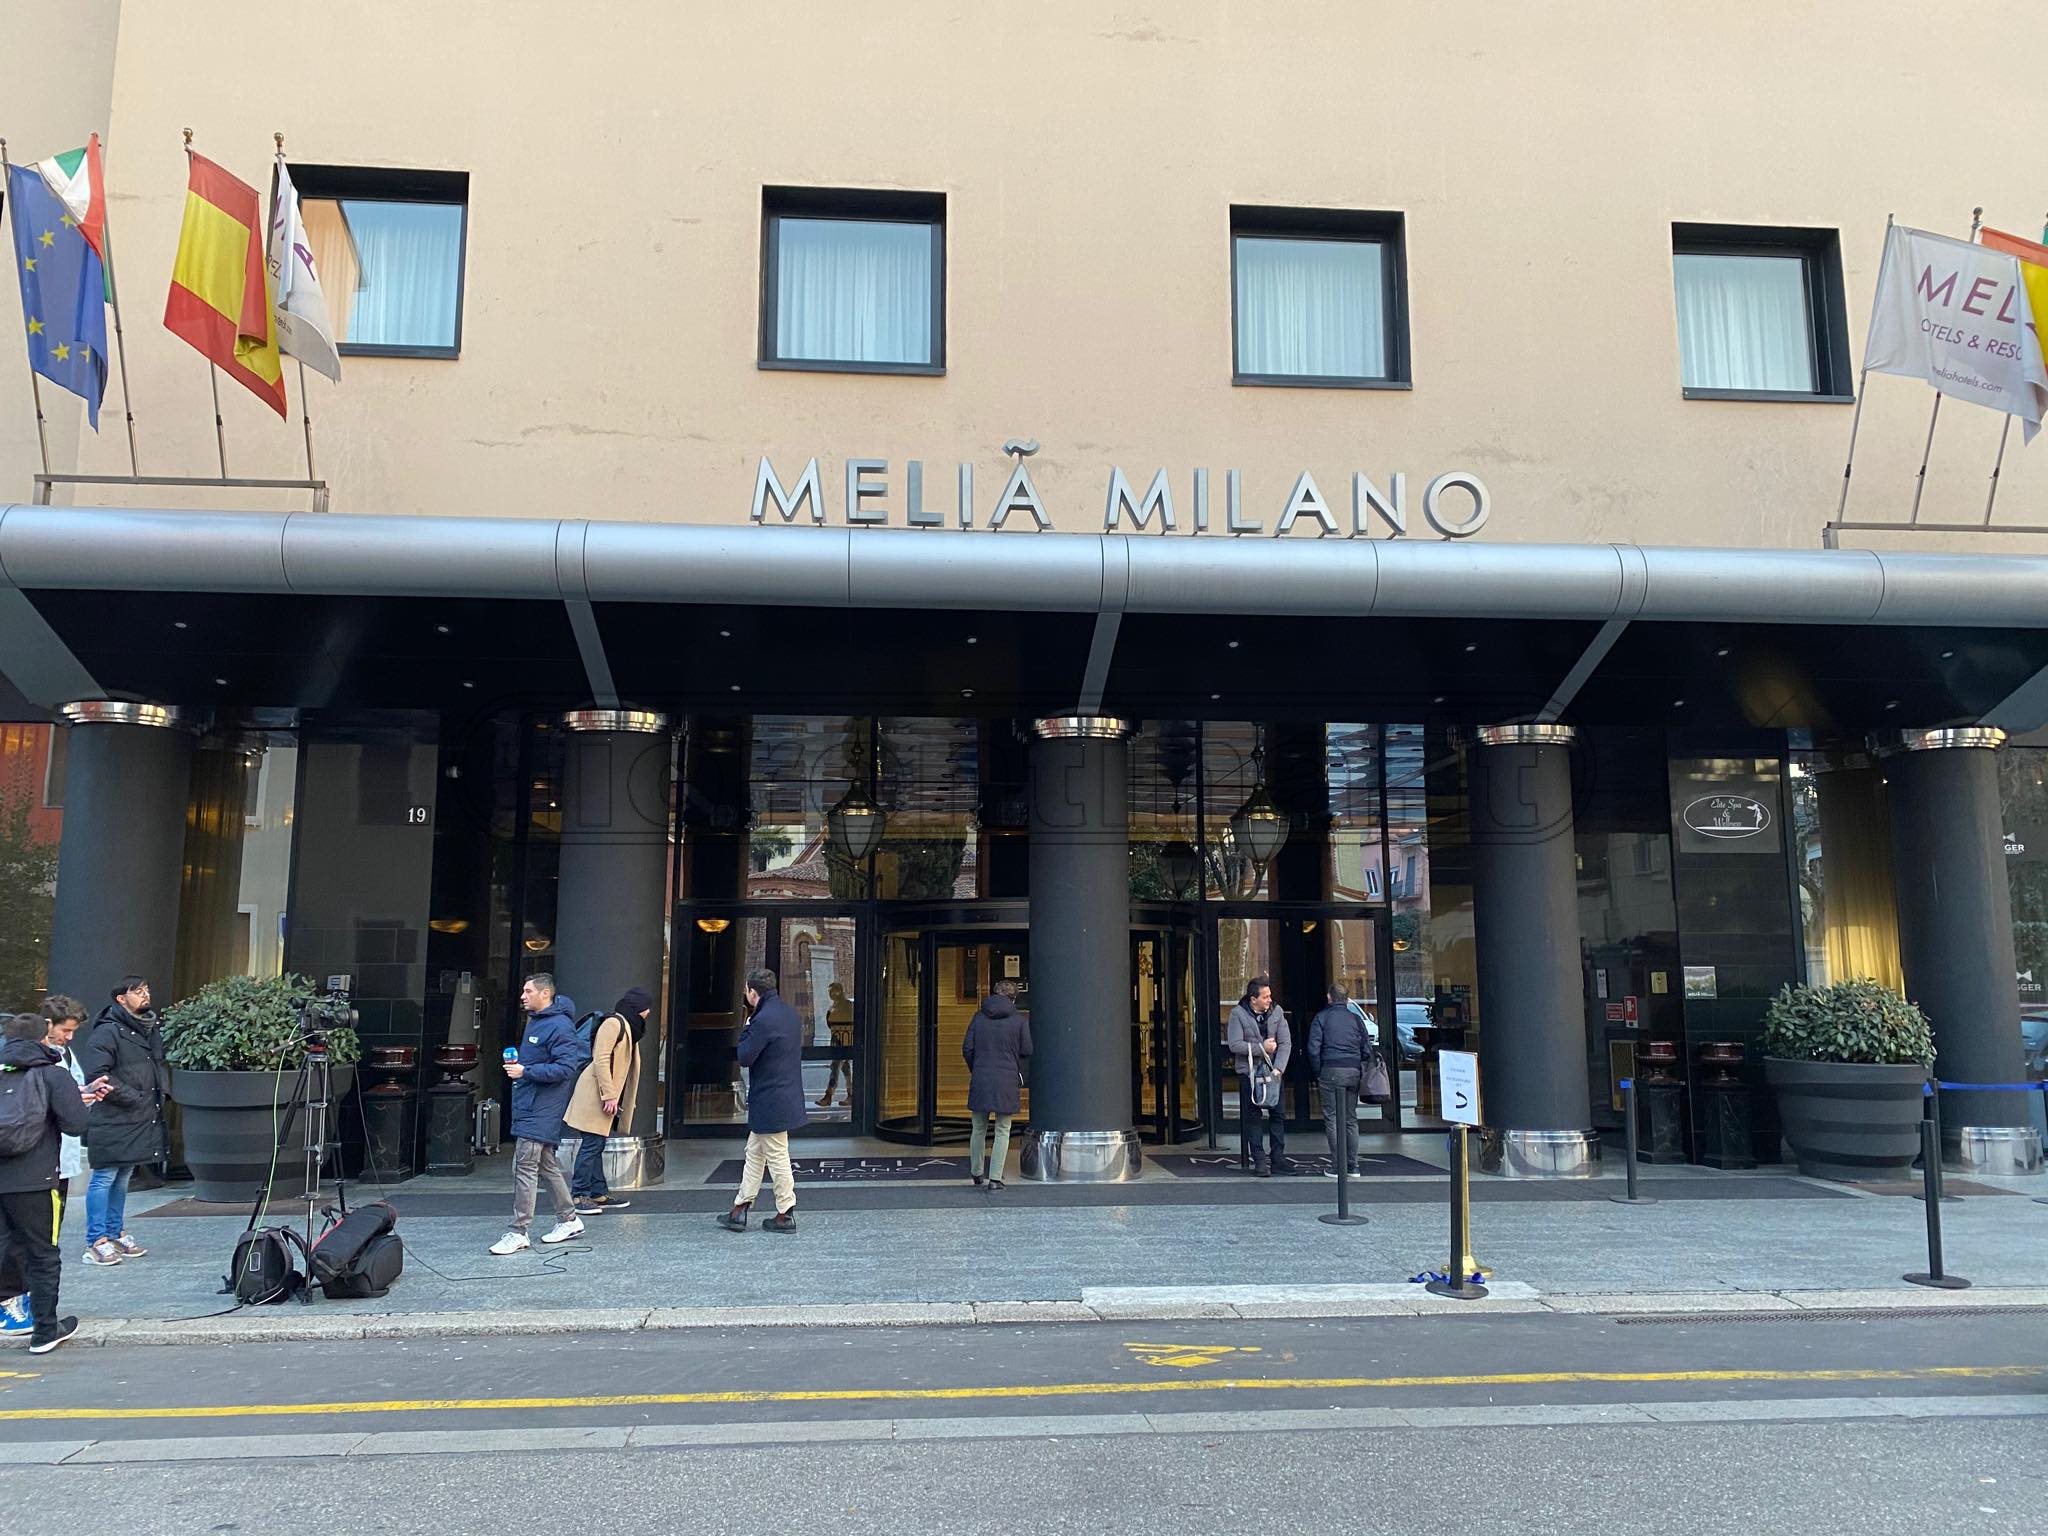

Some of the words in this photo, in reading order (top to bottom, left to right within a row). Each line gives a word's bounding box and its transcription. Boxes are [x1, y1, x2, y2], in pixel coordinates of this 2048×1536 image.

[1917, 263, 2017, 324] MEL
[1920, 318, 1964, 345] OTELS
[1967, 334, 1980, 350] &
[1931, 365, 2003, 393] eliahotels.com
[1103, 465, 1492, 539] MILANO
[408, 807, 426, 823] 19
[1722, 808, 1731, 818] &
[1727, 798, 1742, 811] Spa
[1713, 817, 1742, 827] Wellness
